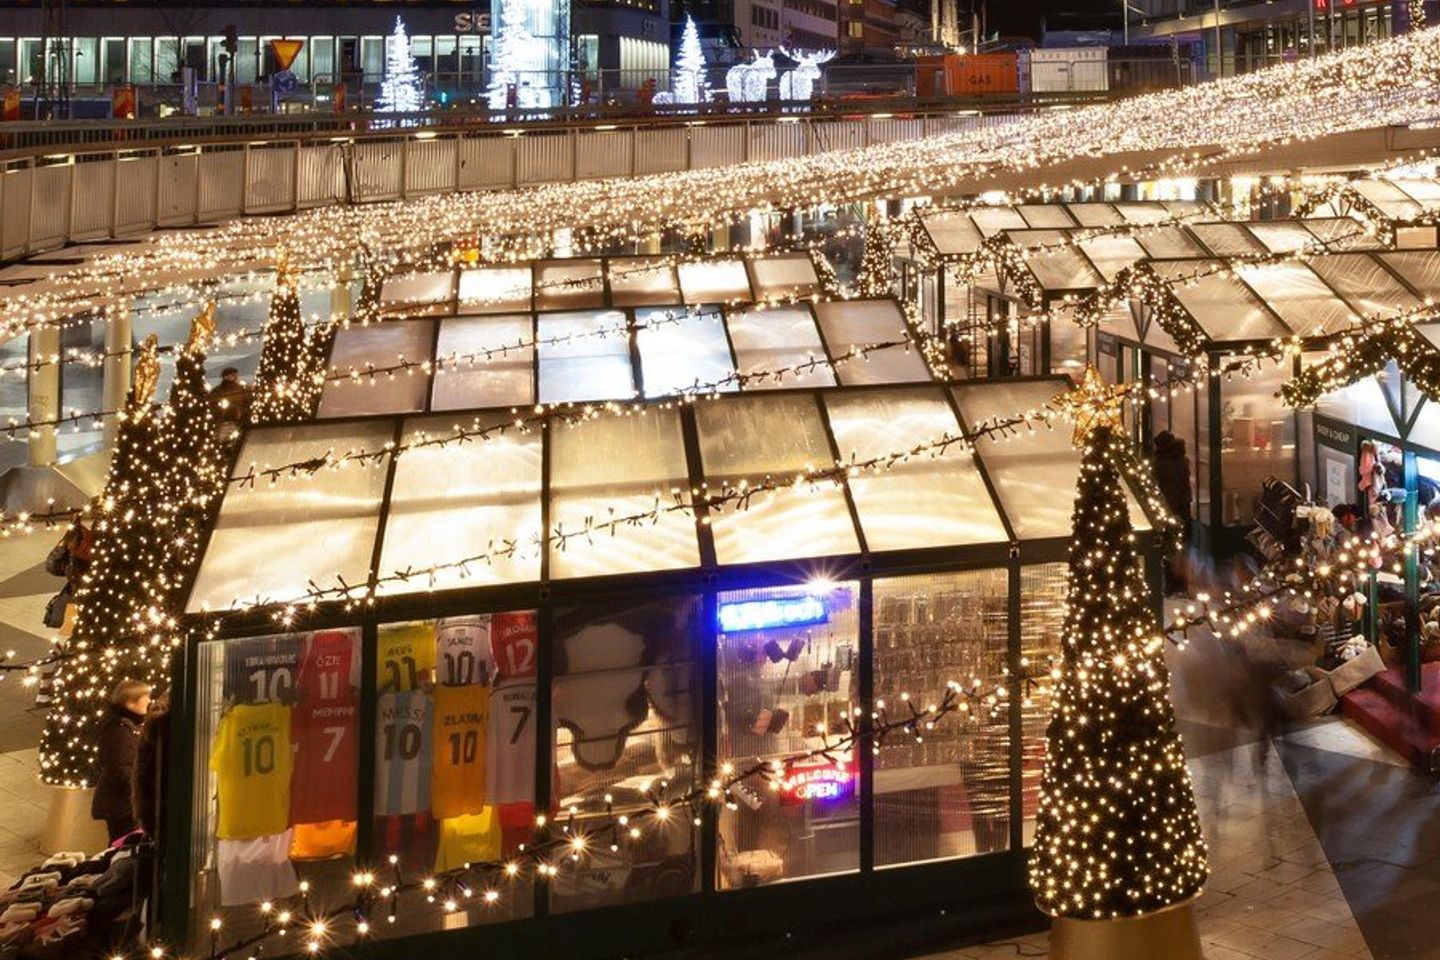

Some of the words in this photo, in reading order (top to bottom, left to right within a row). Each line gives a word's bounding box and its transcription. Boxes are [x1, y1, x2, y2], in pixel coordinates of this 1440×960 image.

[385, 655, 418, 693] 11
[443, 650, 476, 687] 10
[505, 637, 536, 677] 12
[249, 667, 293, 703] 10
[319, 671, 340, 700] 11
[322, 725, 346, 763] 7
[384, 723, 422, 762] 10
[509, 705, 532, 745] 7
[241, 734, 275, 777] 10
[448, 729, 479, 767] 10
[796, 782, 838, 799] OPEN
